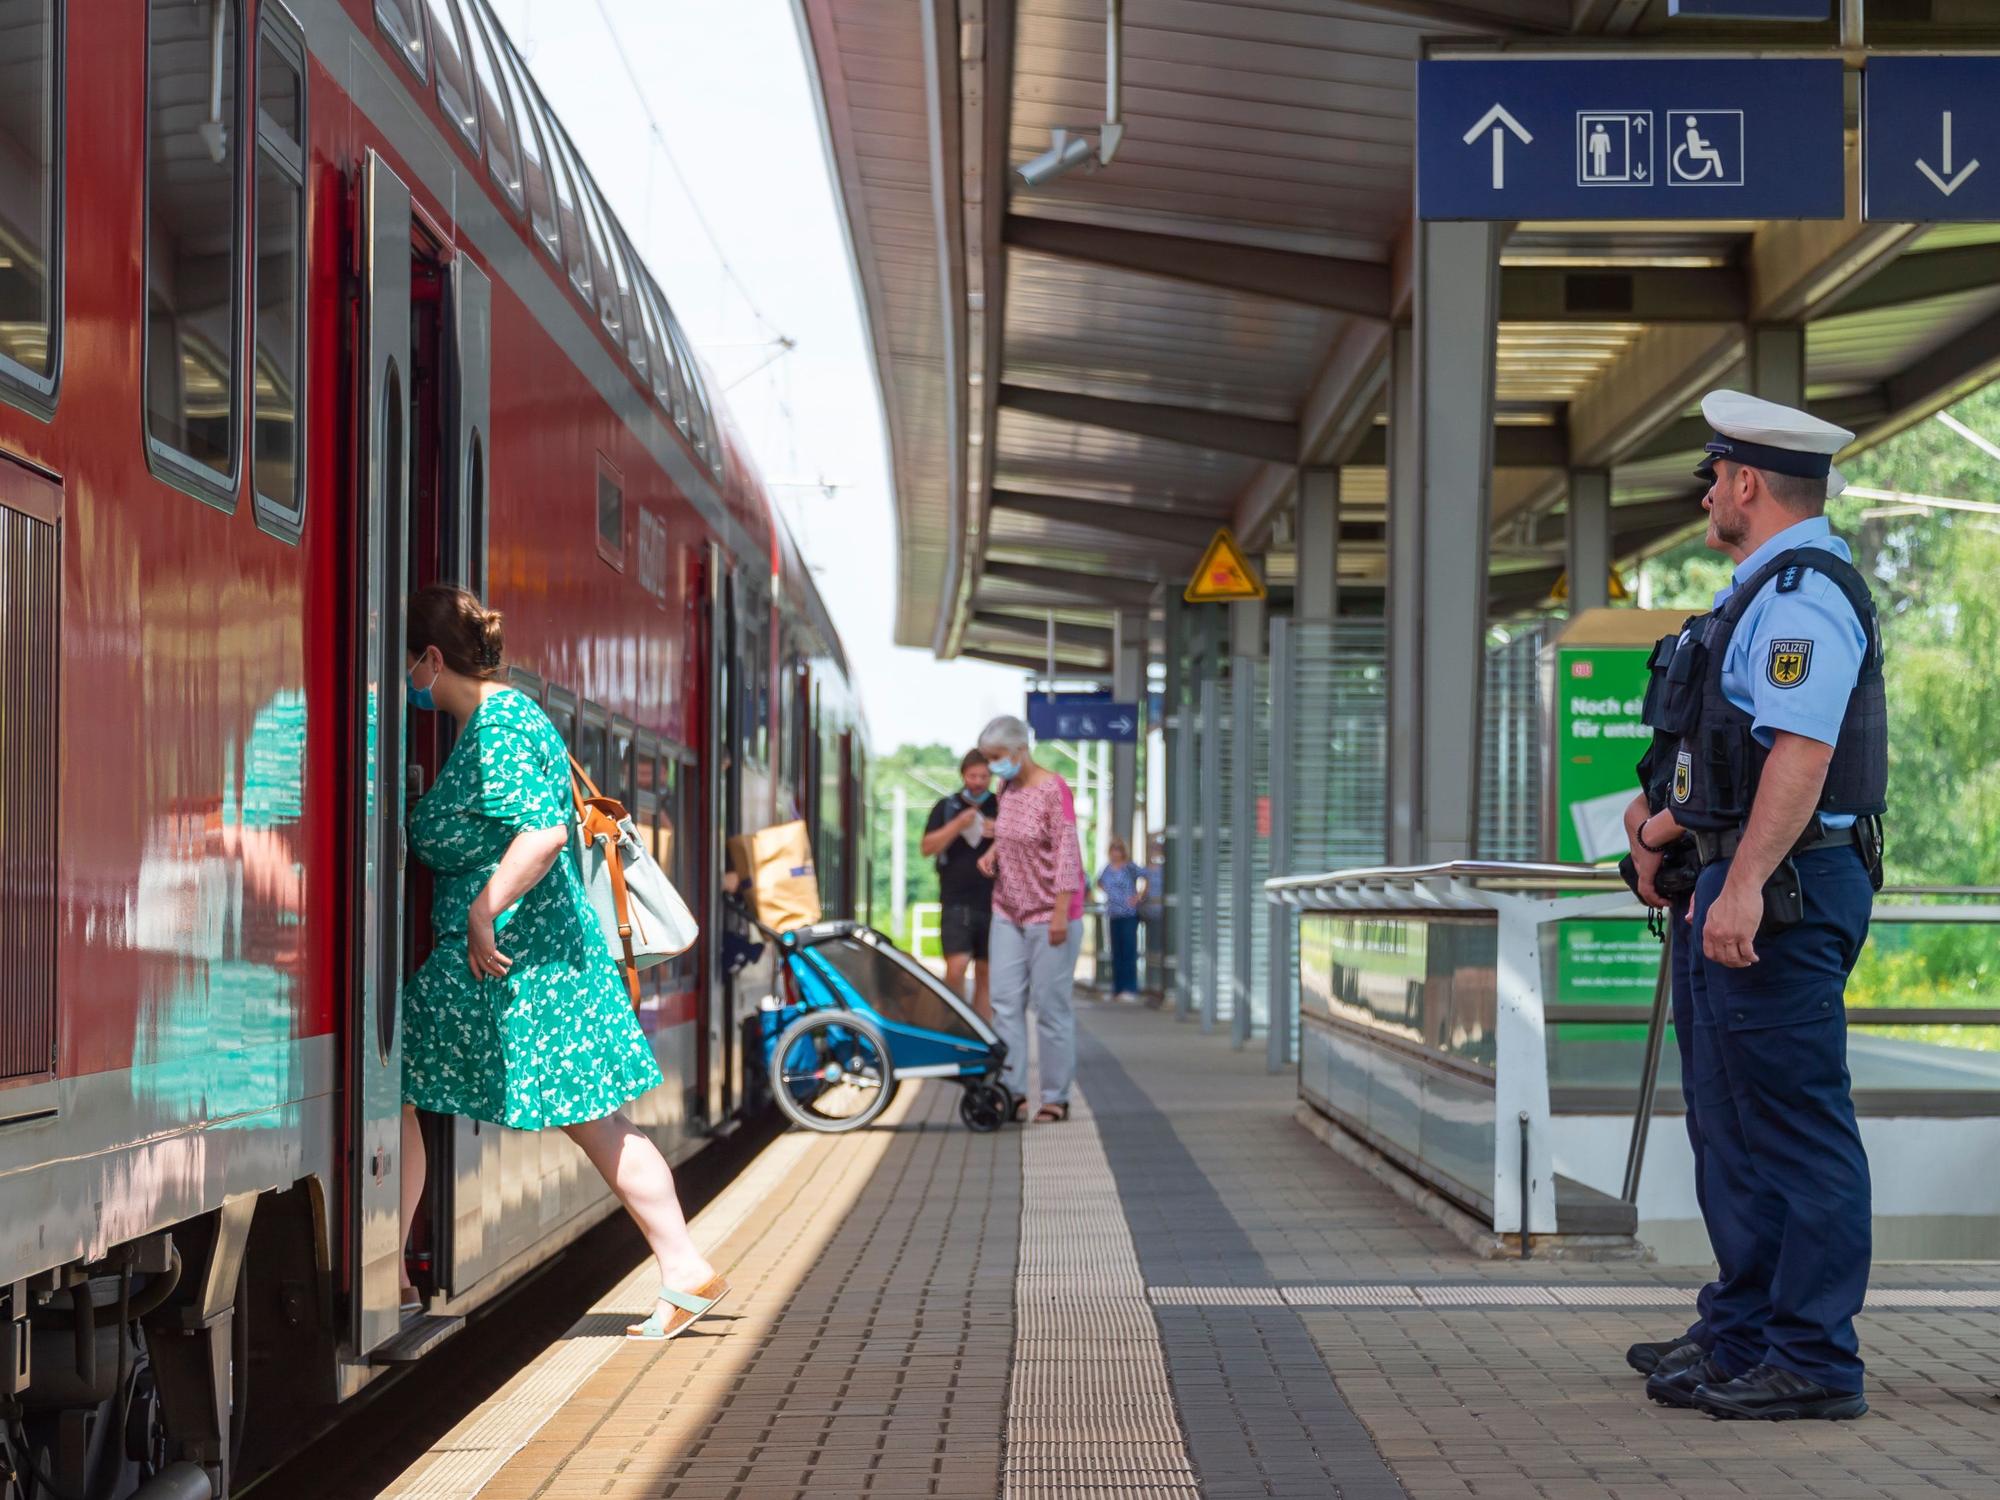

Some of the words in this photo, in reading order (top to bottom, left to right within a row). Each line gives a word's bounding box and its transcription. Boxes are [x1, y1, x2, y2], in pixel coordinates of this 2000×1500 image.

[1773, 643, 1808, 654] POLIZEI
[1571, 697, 1620, 715] Noch
[1571, 719, 1600, 737] für
